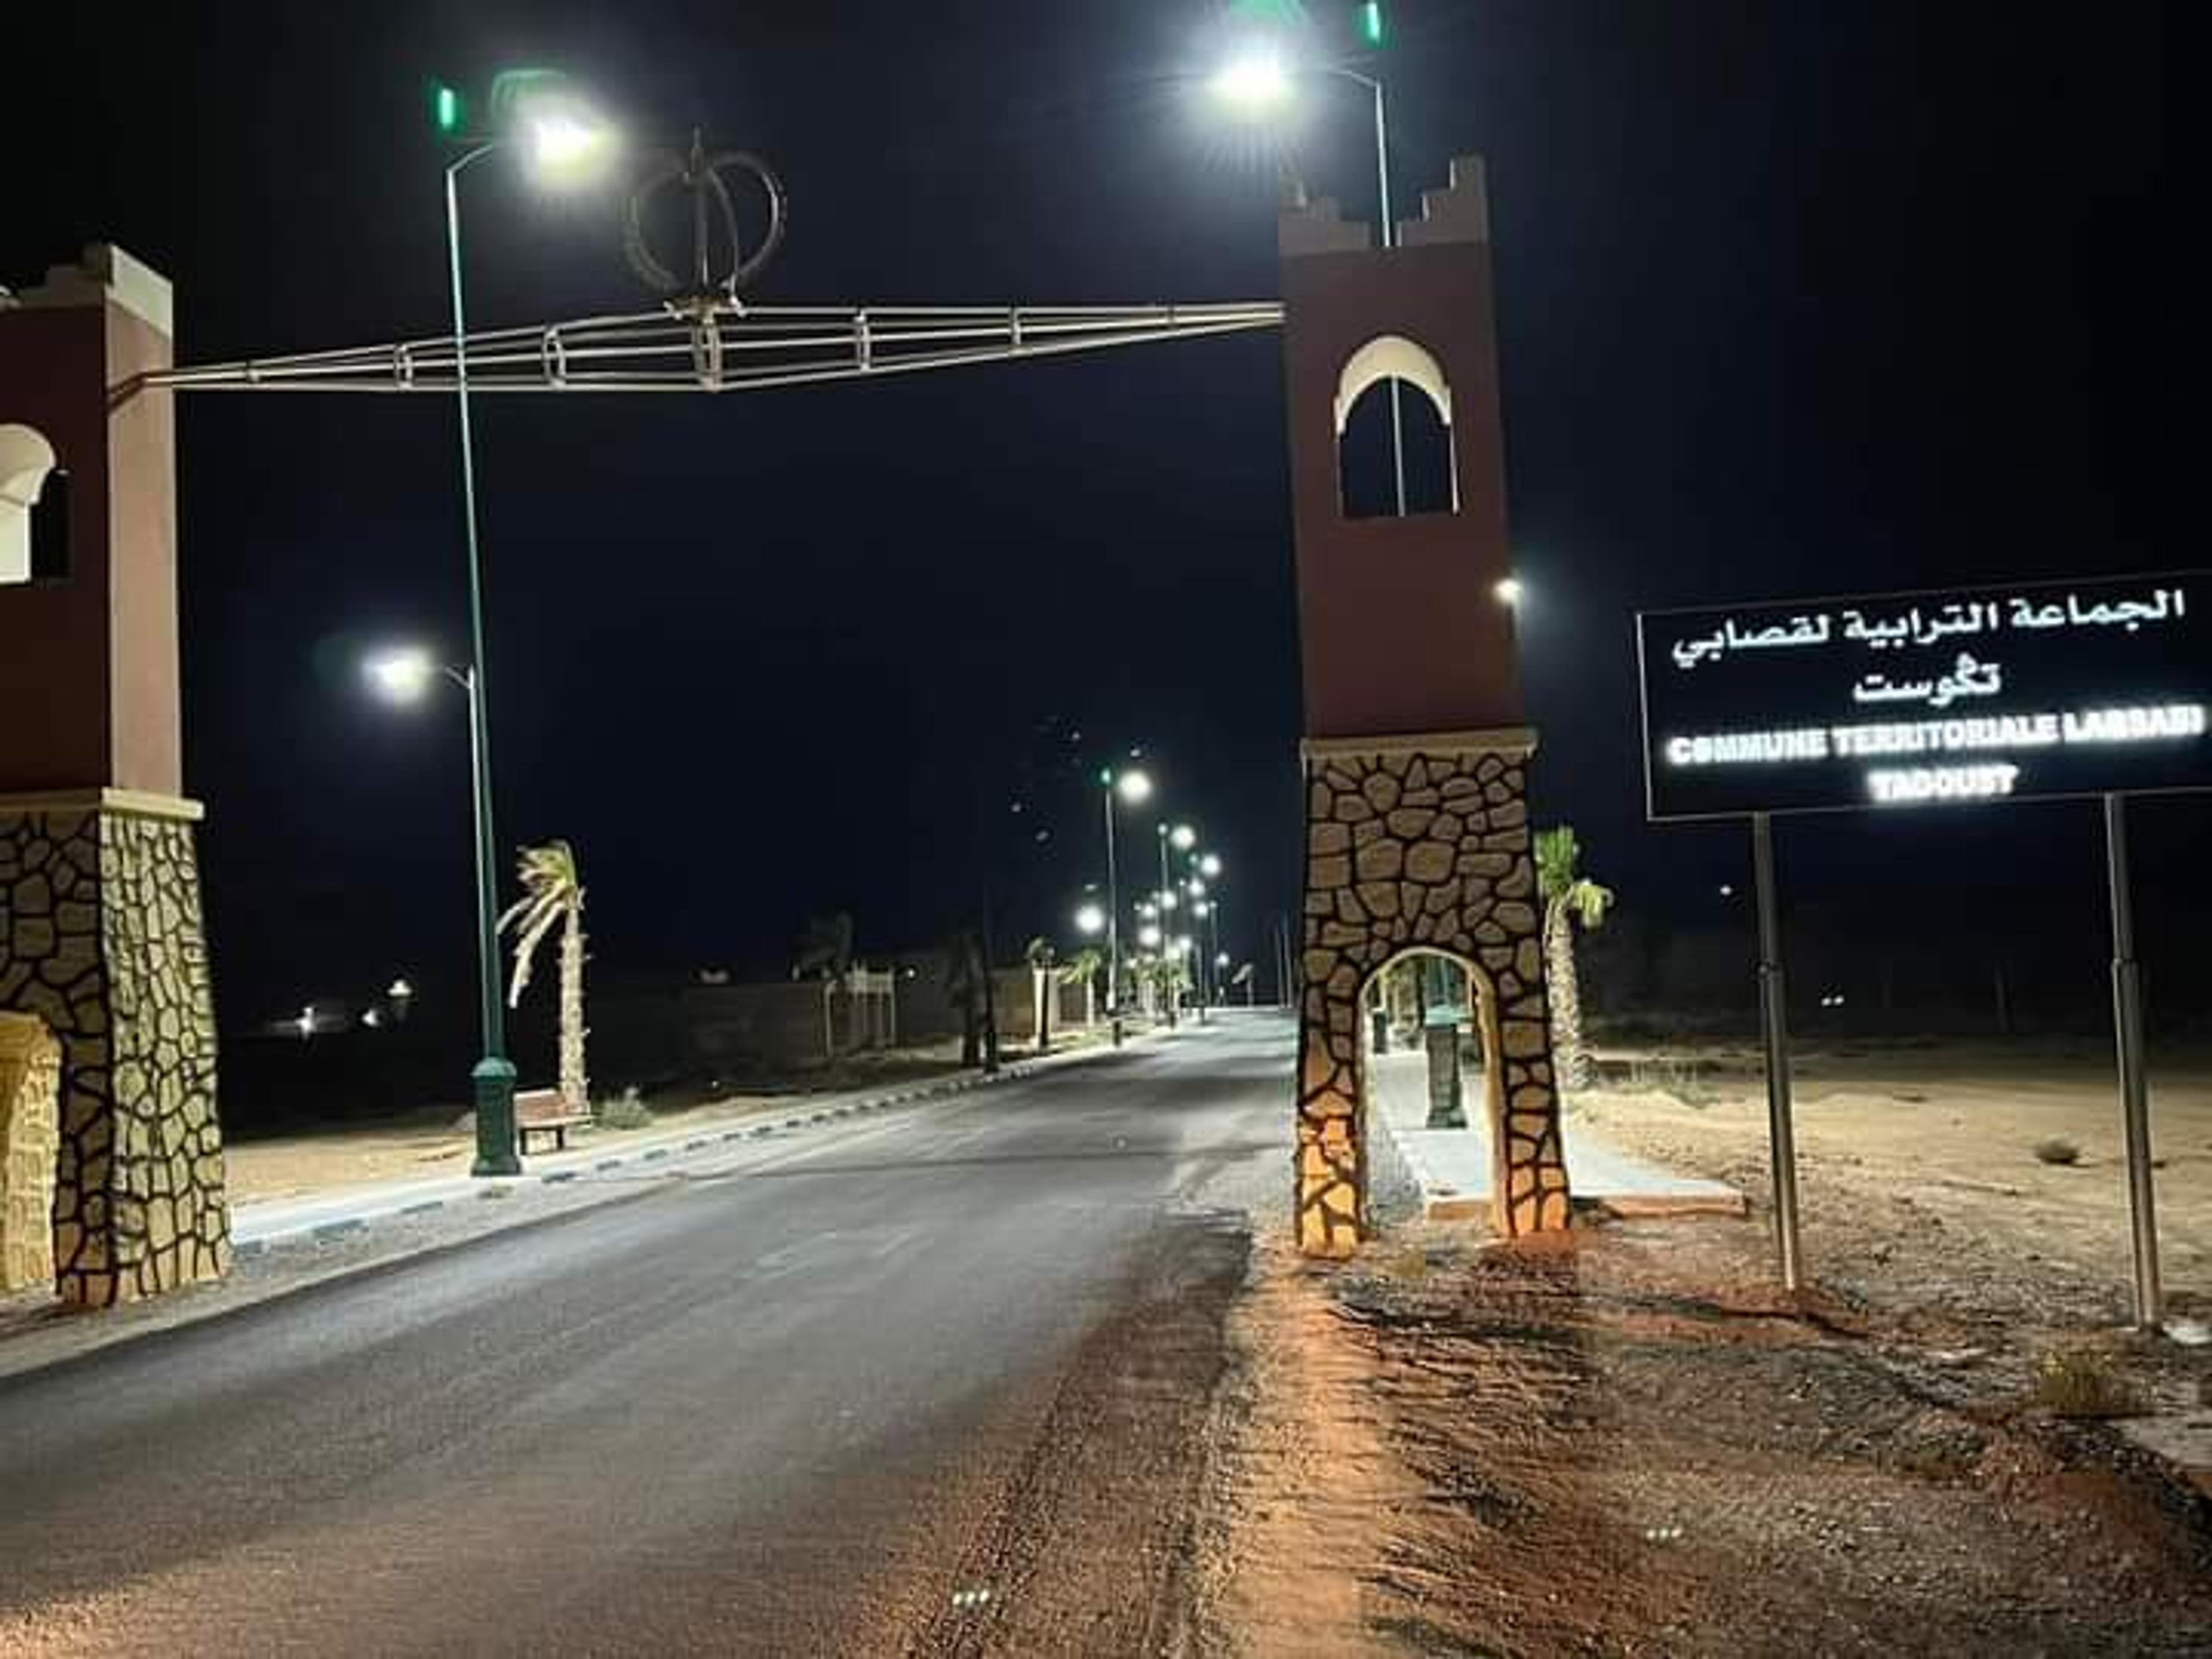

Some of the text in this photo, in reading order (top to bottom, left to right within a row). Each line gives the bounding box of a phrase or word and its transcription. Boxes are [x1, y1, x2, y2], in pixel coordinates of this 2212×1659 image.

[1672, 590, 2184, 668] الجماعة الترابية لقصابي
[1666, 727, 1828, 766] COMMUNE
[1831, 712, 2060, 757] TERRITORIALE
